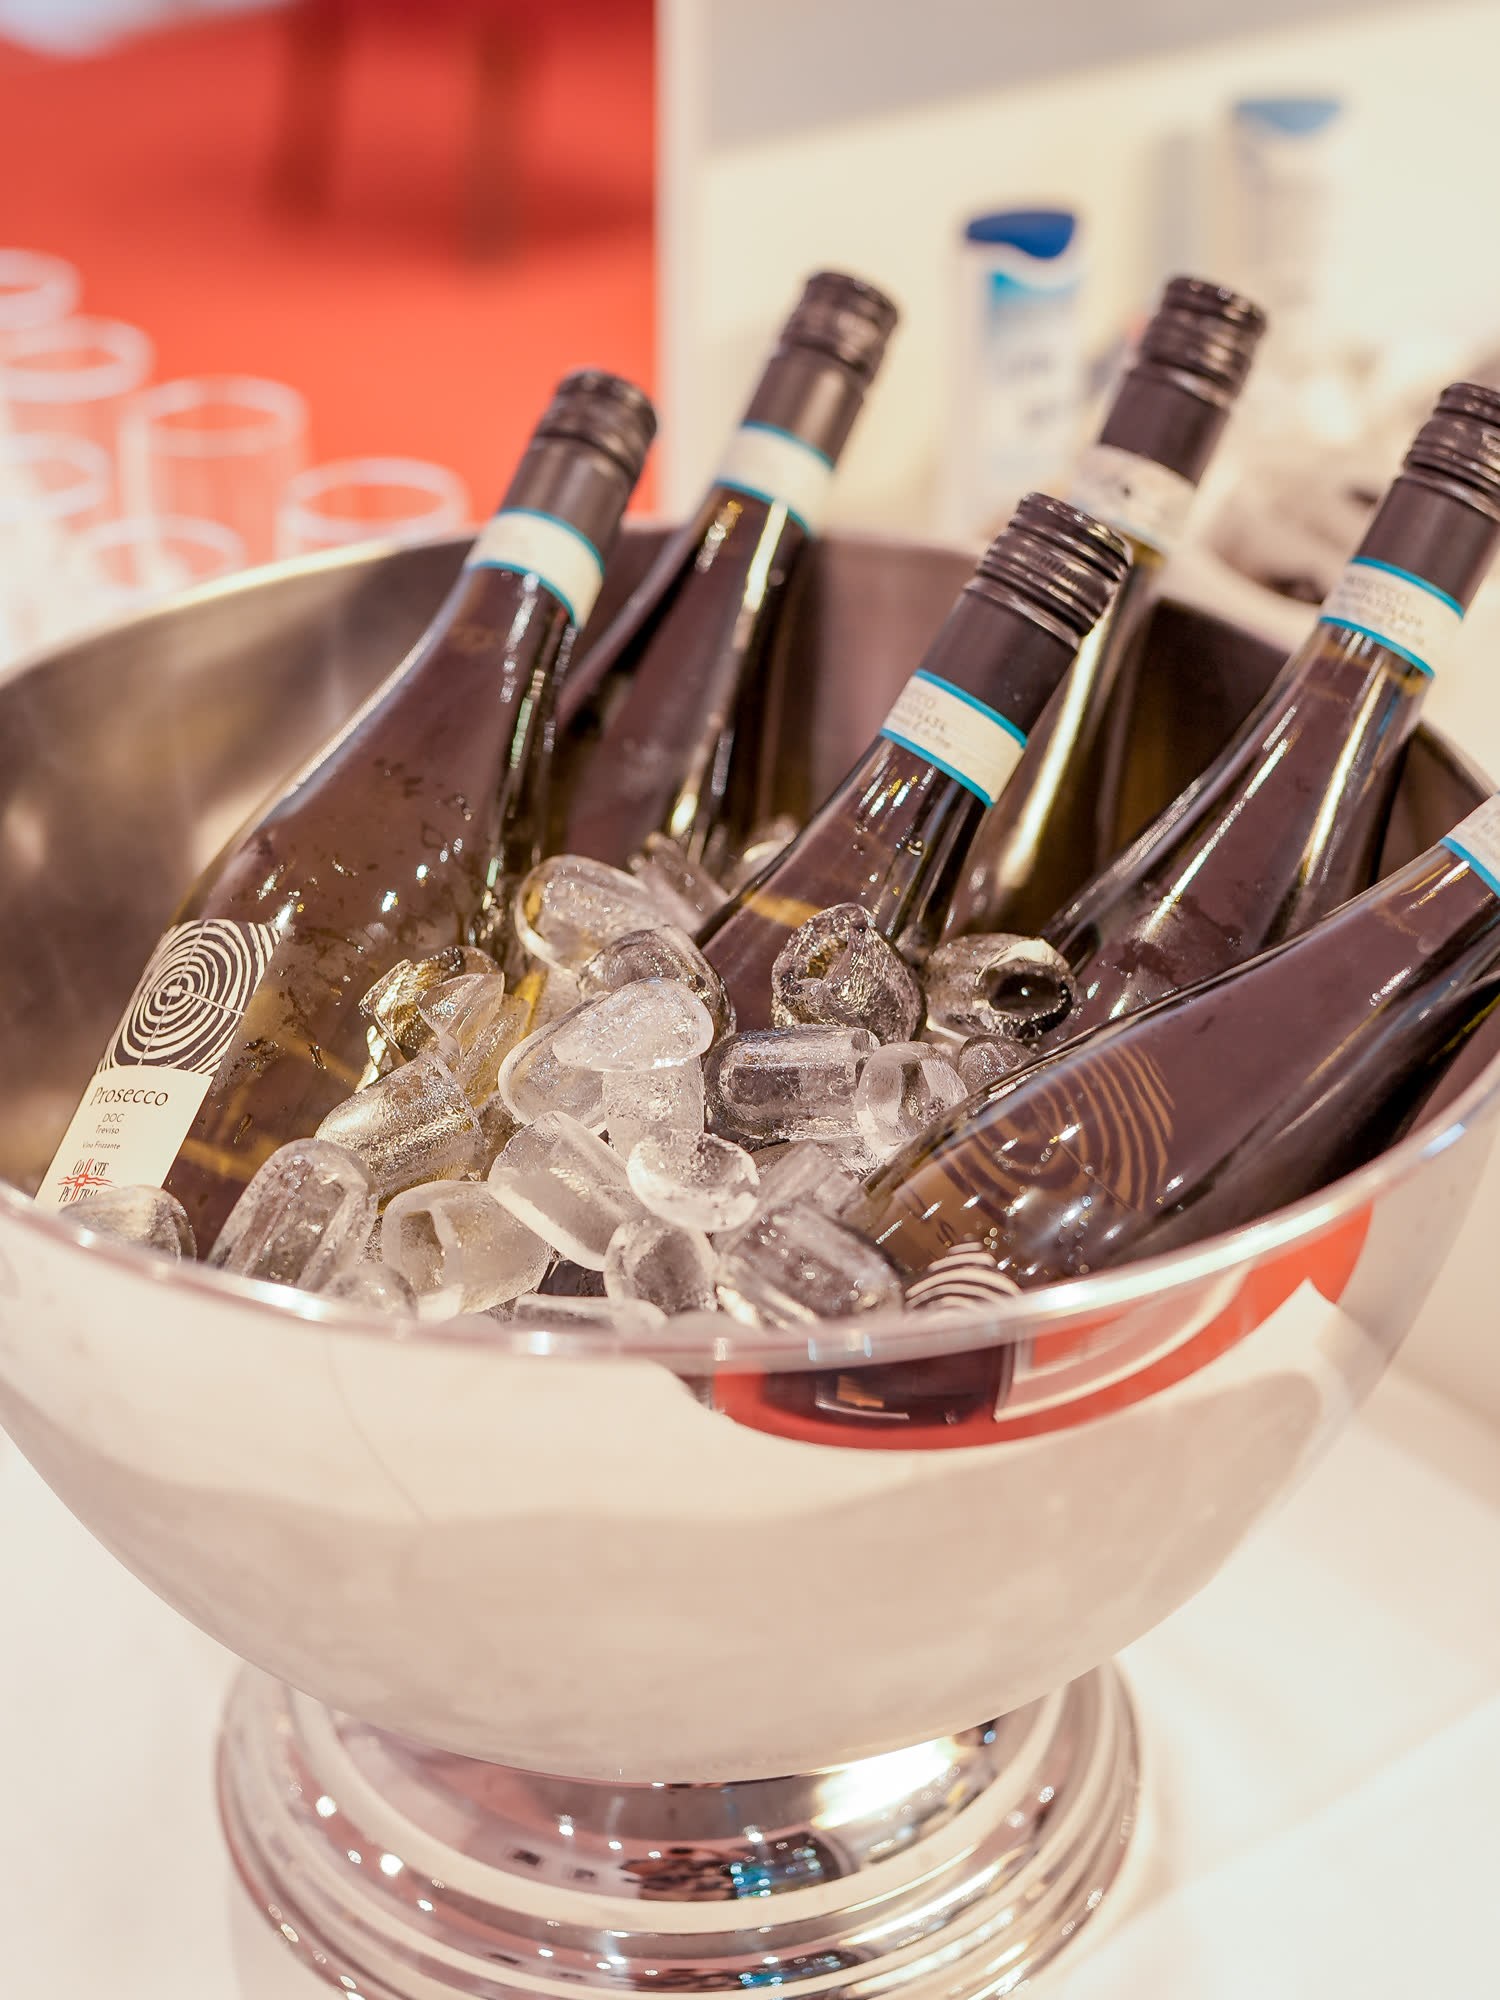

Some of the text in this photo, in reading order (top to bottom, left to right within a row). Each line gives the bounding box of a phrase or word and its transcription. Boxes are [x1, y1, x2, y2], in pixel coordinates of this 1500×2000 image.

[90, 1086, 168, 1106] Prosecco
[102, 1112, 125, 1123] DOC
[95, 1124, 120, 1135] Treviso
[94, 1140, 121, 1150] Frizzante
